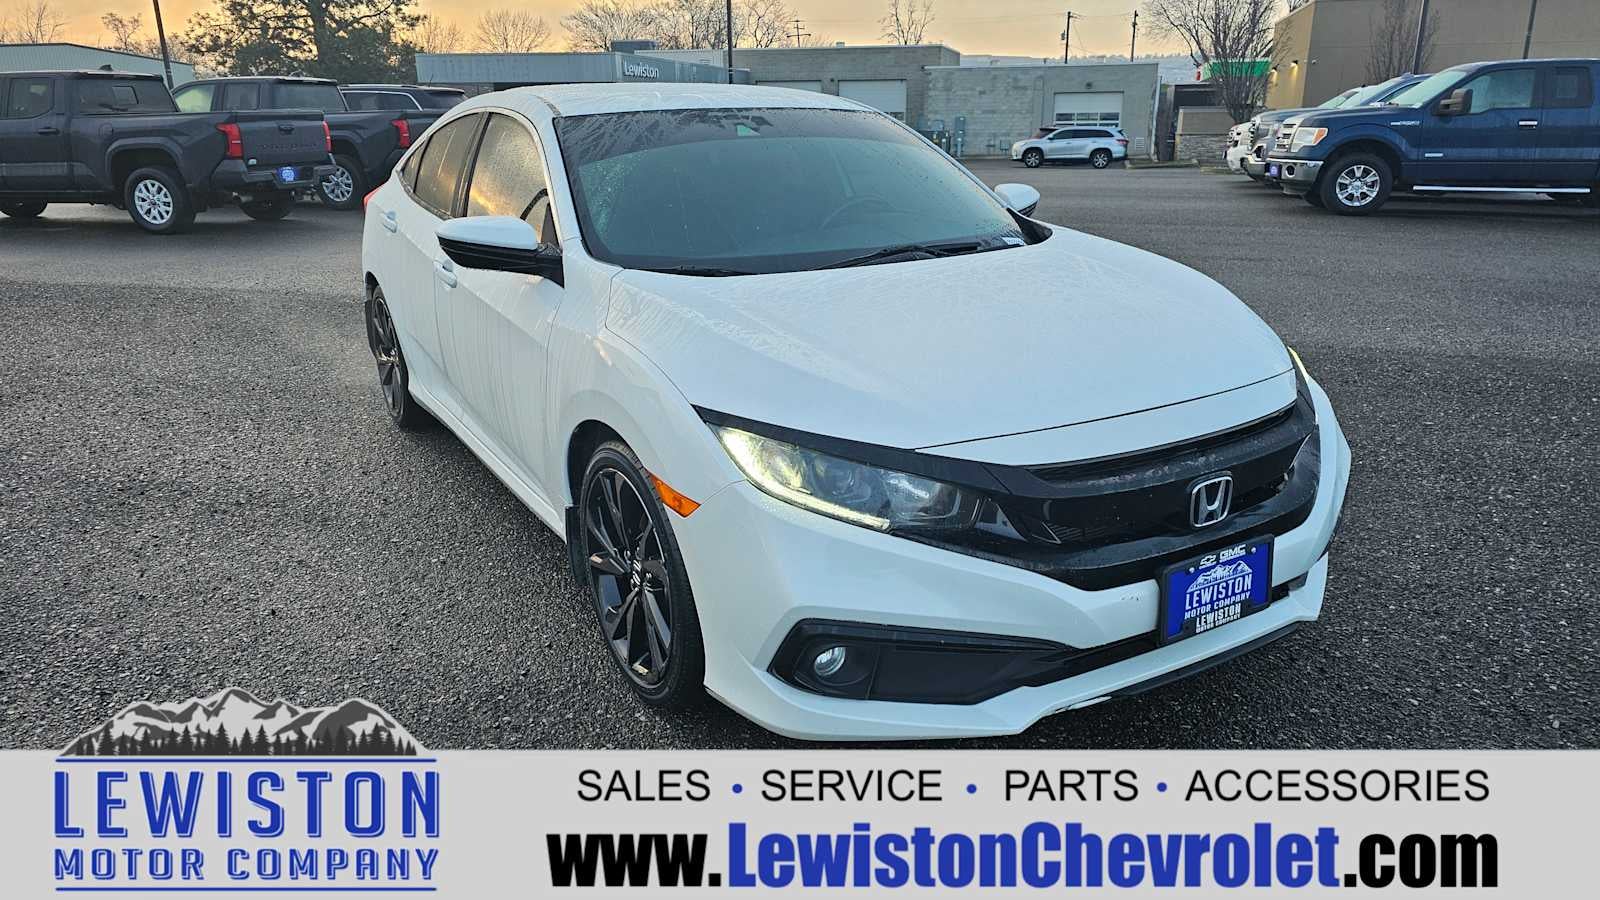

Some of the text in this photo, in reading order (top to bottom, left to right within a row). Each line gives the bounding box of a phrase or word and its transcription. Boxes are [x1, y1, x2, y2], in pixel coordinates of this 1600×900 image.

[624, 60, 659, 78] Lewiston
[1219, 544, 1246, 560] GMC
[1185, 573, 1253, 610] LEWISTON
[1184, 591, 1251, 620] MOTOR COMPANY
[1196, 602, 1241, 628] LEWISTON
